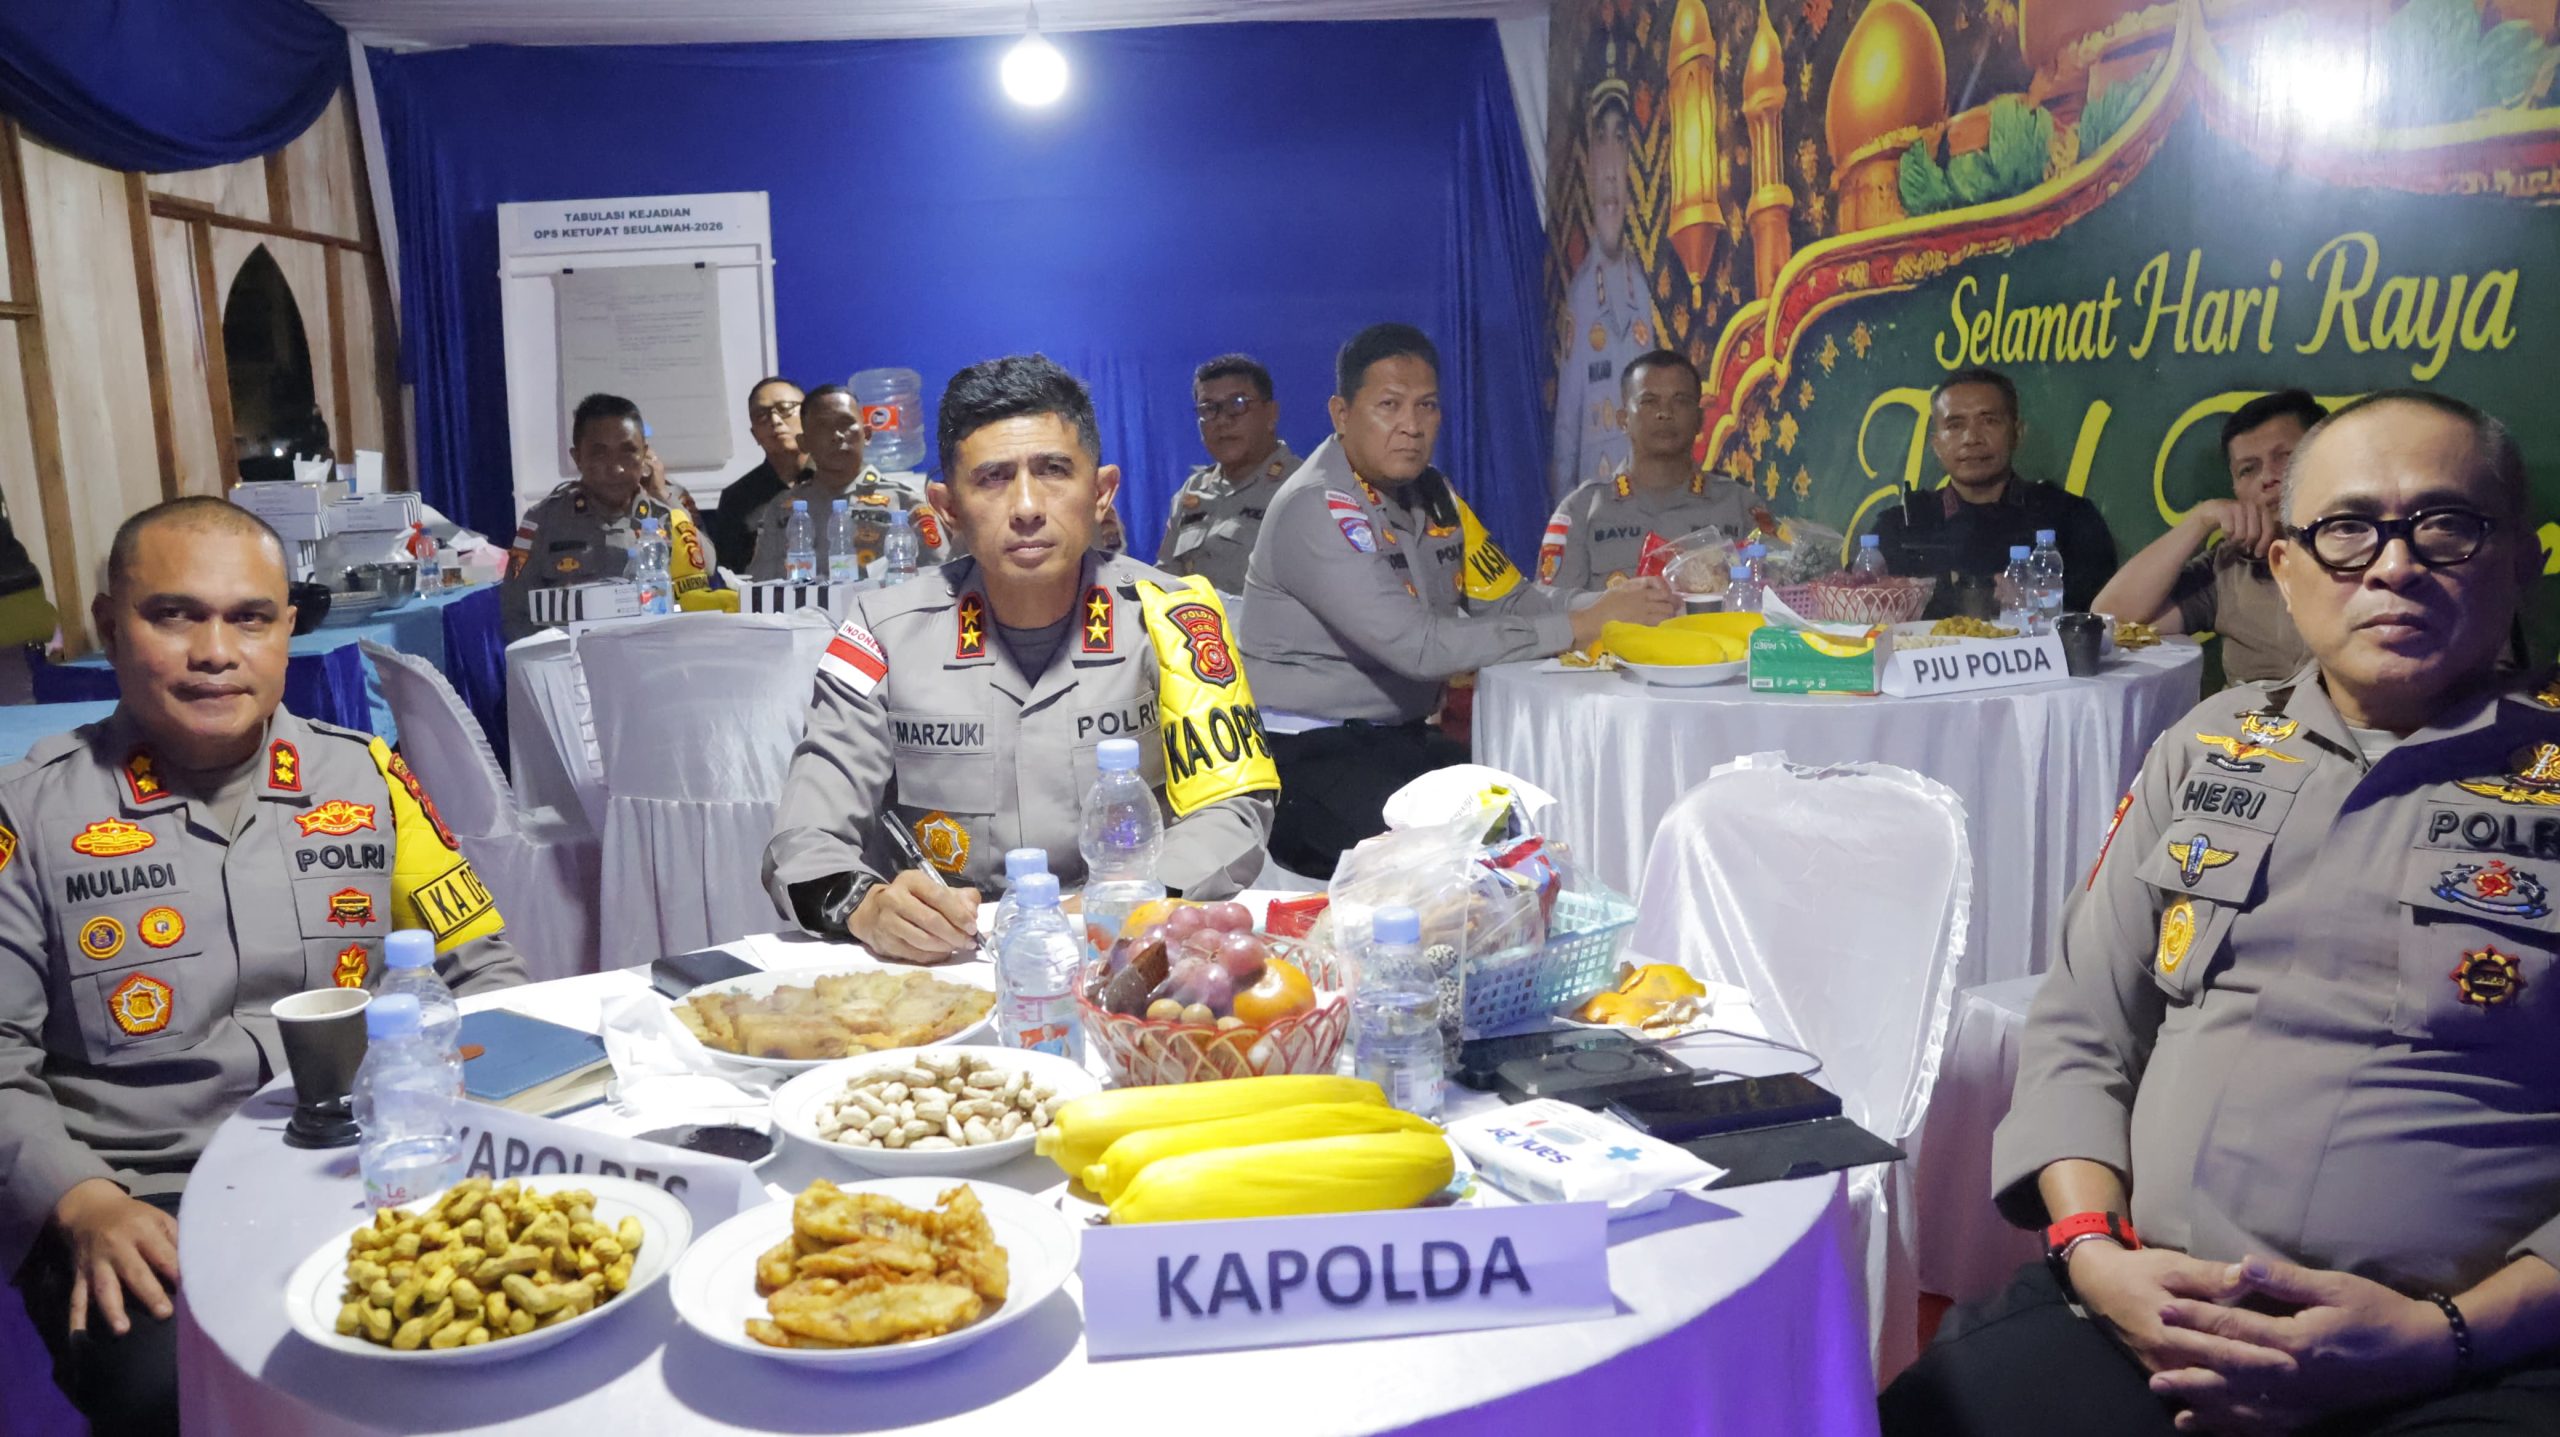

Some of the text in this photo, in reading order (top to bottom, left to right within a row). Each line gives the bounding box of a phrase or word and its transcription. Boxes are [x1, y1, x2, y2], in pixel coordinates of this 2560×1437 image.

[533, 229, 558, 240] OPS
[562, 226, 619, 238] KETUPAT
[564, 208, 691, 223] TABULASI KEJADIAN
[1935, 231, 2519, 381] Selamat Hari Raya
[1594, 526, 1640, 542] BAYU
[1913, 647, 2052, 684] PJU POLDA
[895, 721, 984, 747] MARZUKI
[1077, 701, 1157, 739] POLRI
[1164, 704, 1272, 785] KA OPS
[2182, 780, 2267, 820] HERI
[2428, 810, 2560, 861] POLR
[295, 844, 385, 872] POLRI
[66, 862, 176, 904] MULIADI
[427, 879, 473, 927] KA
[1156, 1235, 1532, 1319] KAPOLDA
